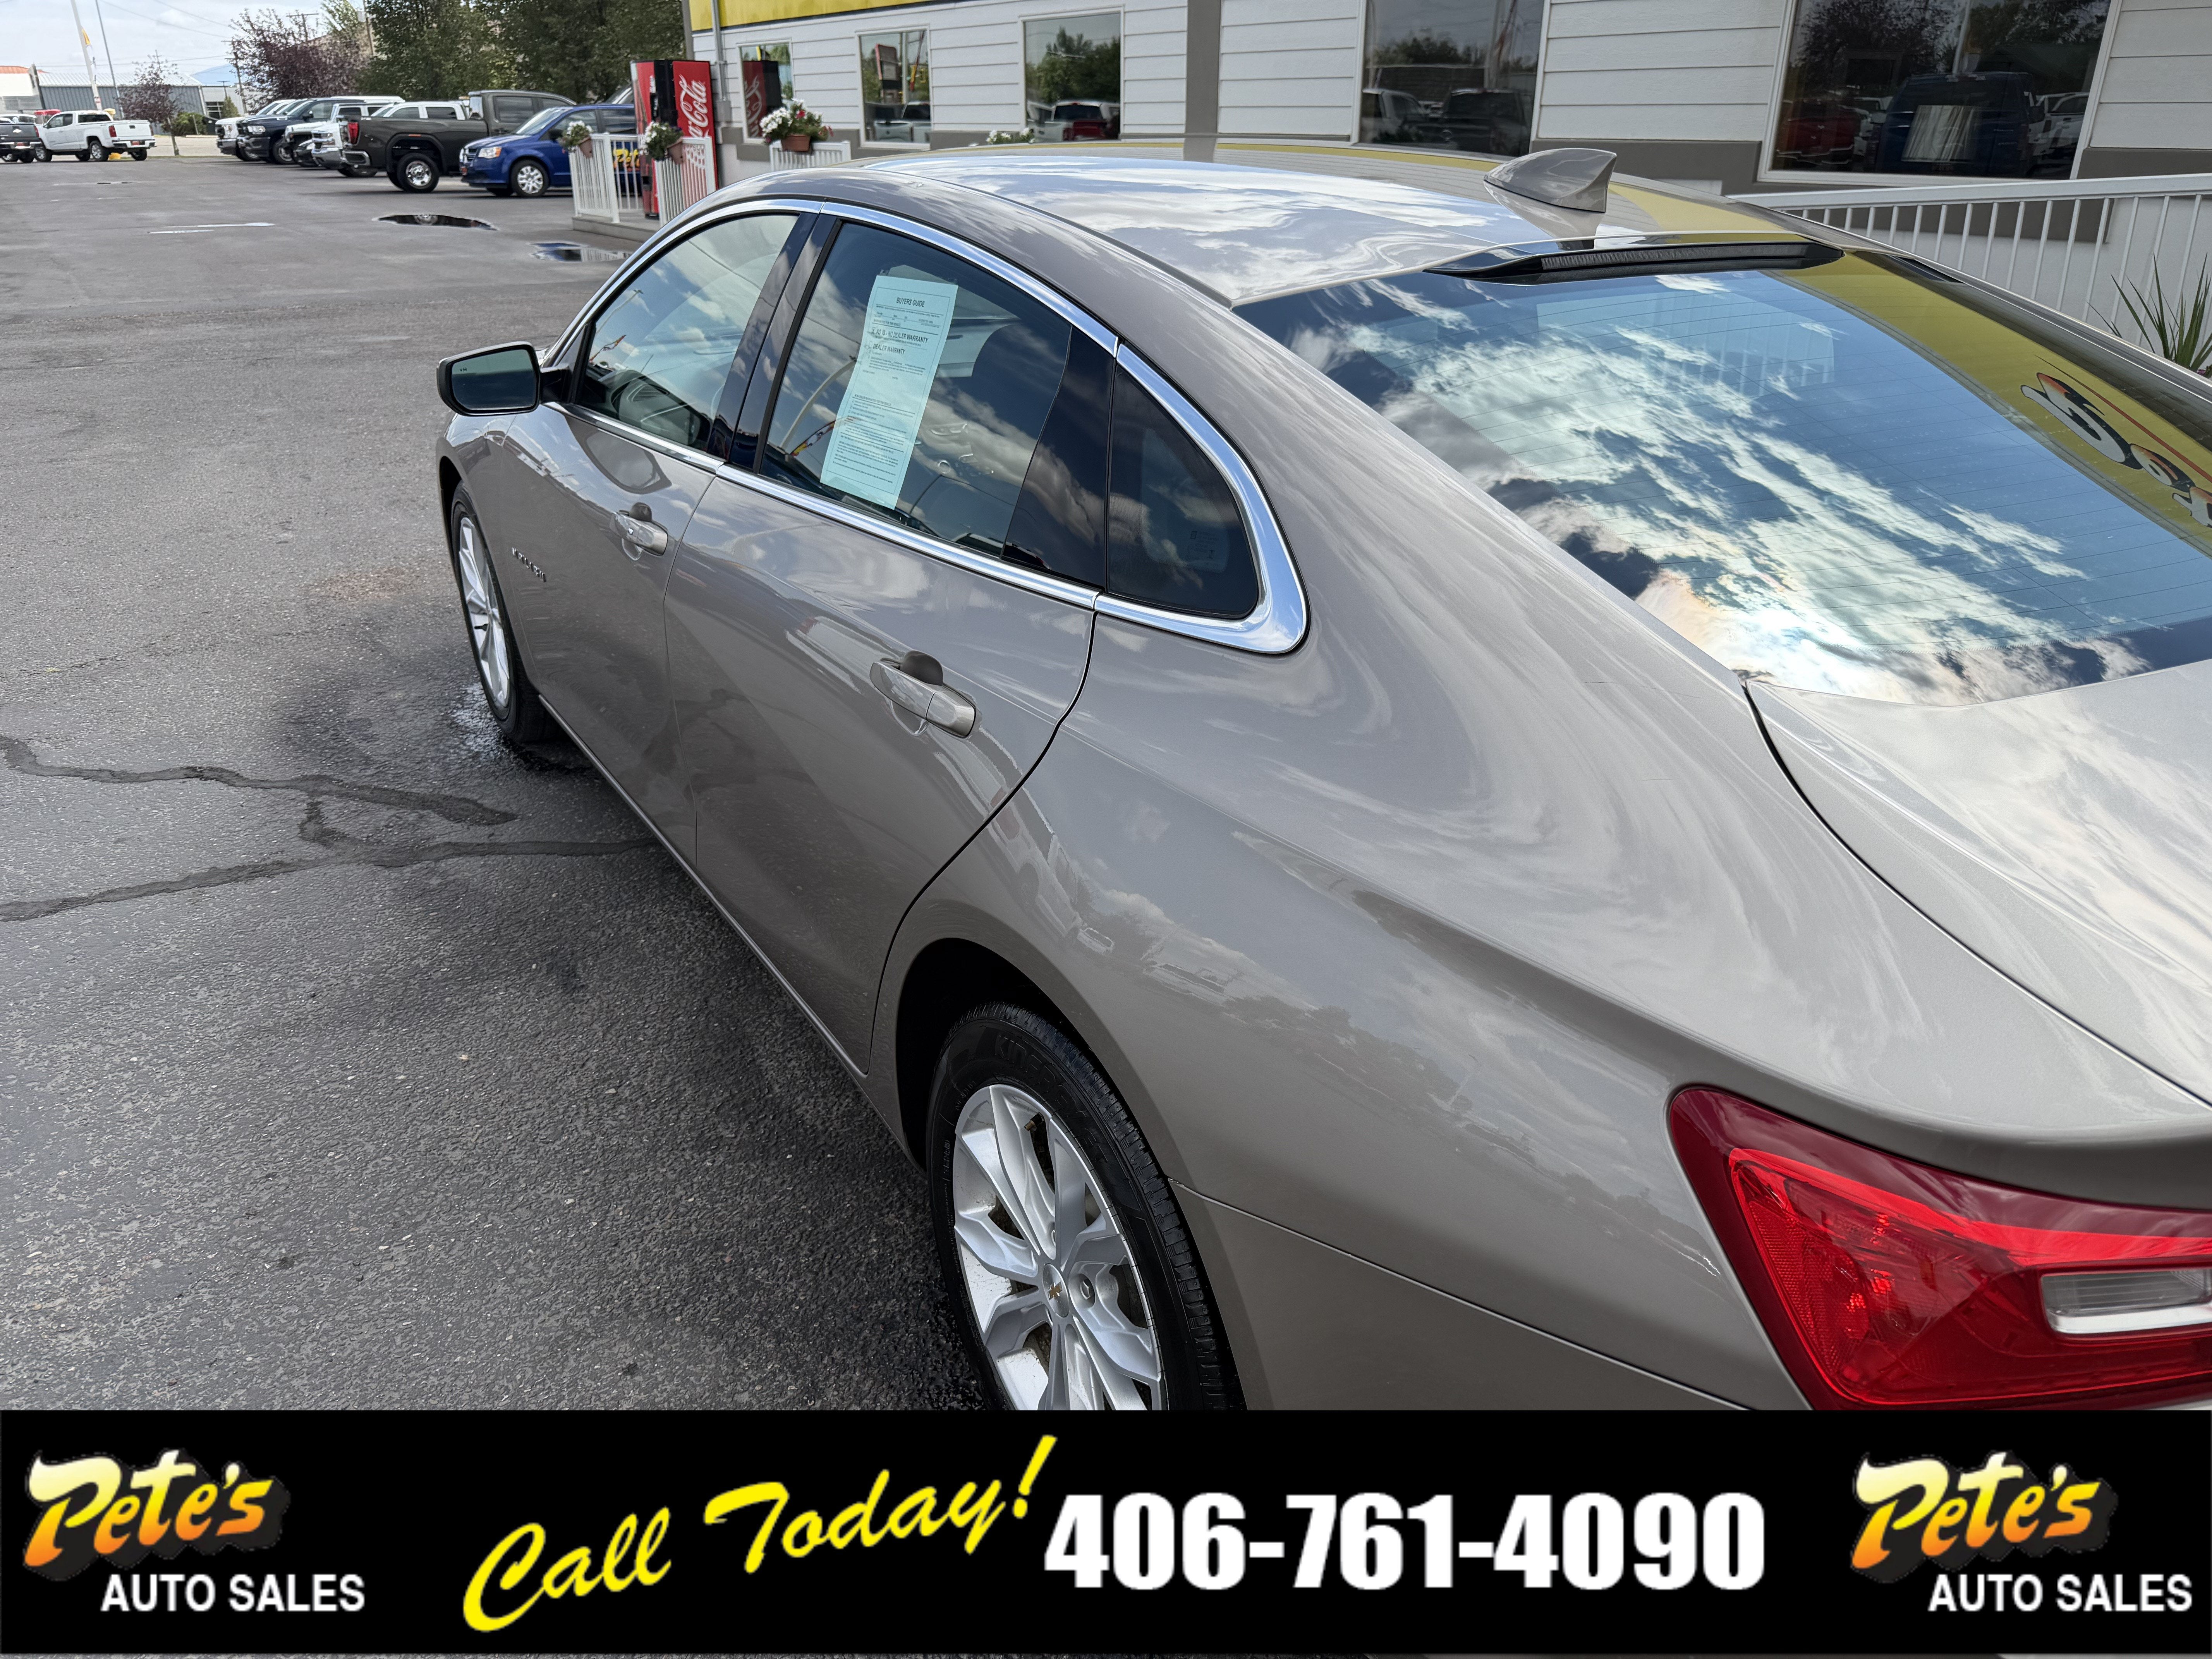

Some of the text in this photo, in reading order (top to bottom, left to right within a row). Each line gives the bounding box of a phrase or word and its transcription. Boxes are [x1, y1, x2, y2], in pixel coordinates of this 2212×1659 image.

[893, 331, 907, 340] DEALER
[907, 334, 929, 343] WARRANTY
[887, 345, 905, 354] WARRANTY
